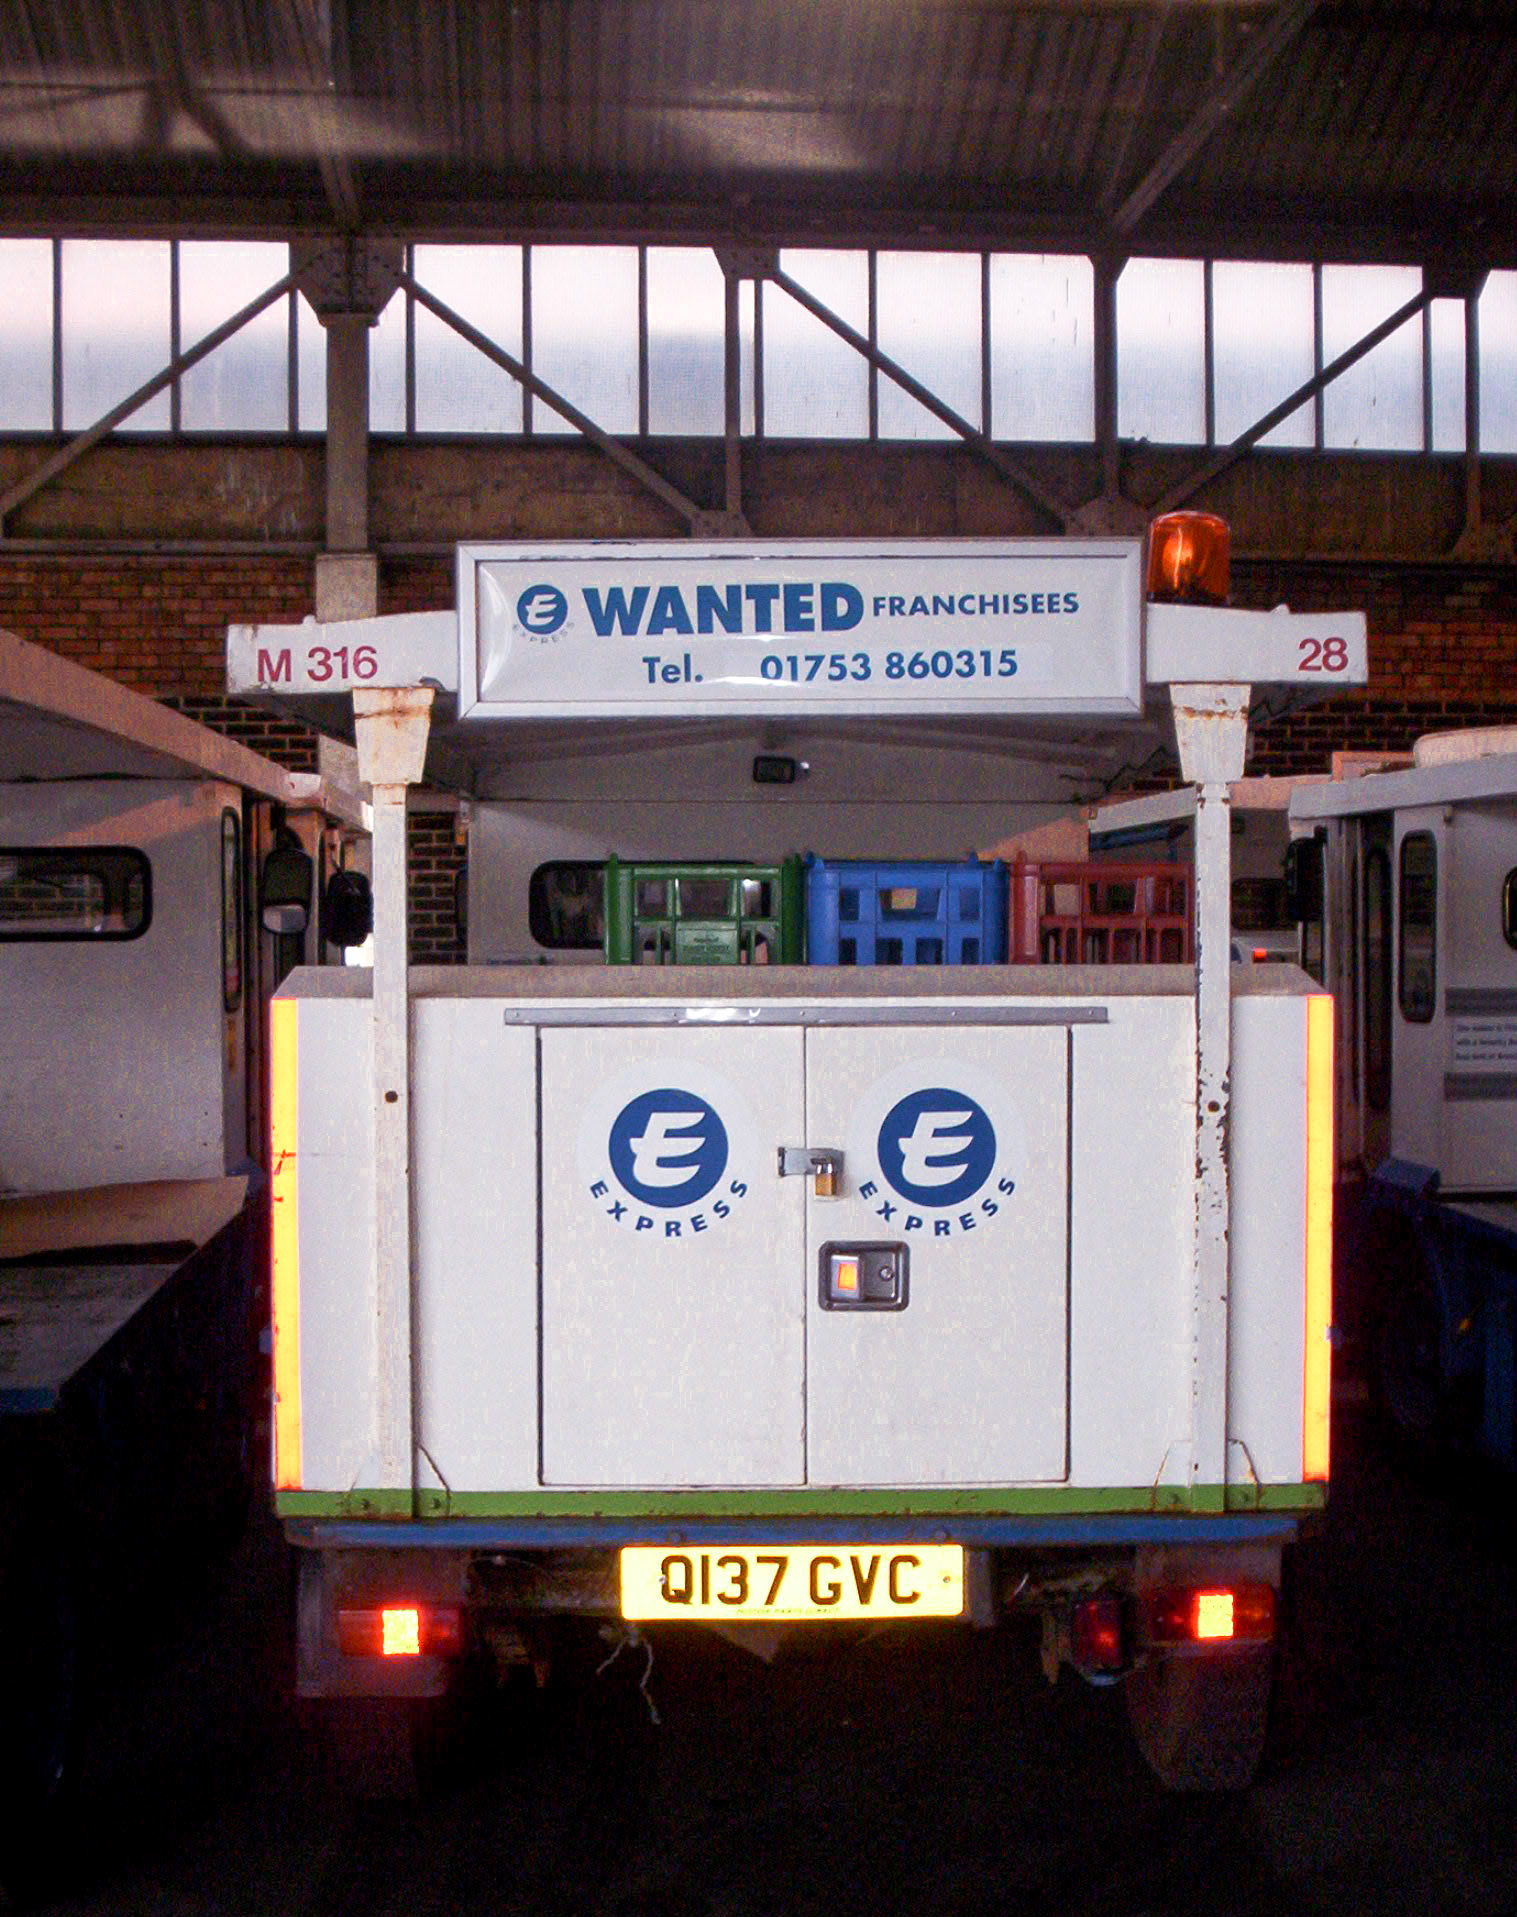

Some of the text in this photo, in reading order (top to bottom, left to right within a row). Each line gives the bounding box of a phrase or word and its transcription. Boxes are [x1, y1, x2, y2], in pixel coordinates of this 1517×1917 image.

[582, 582, 1080, 637] WANTED FRANCHISEES
[257, 645, 378, 683] M 316
[642, 649, 1018, 684] Tel. 01753 860315
[1298, 637, 1348, 672] 28
[589, 1178, 748, 1238] EXPRESS
[858, 1177, 1016, 1237] EXPRESS
[809, 1555, 921, 1605] GVC
